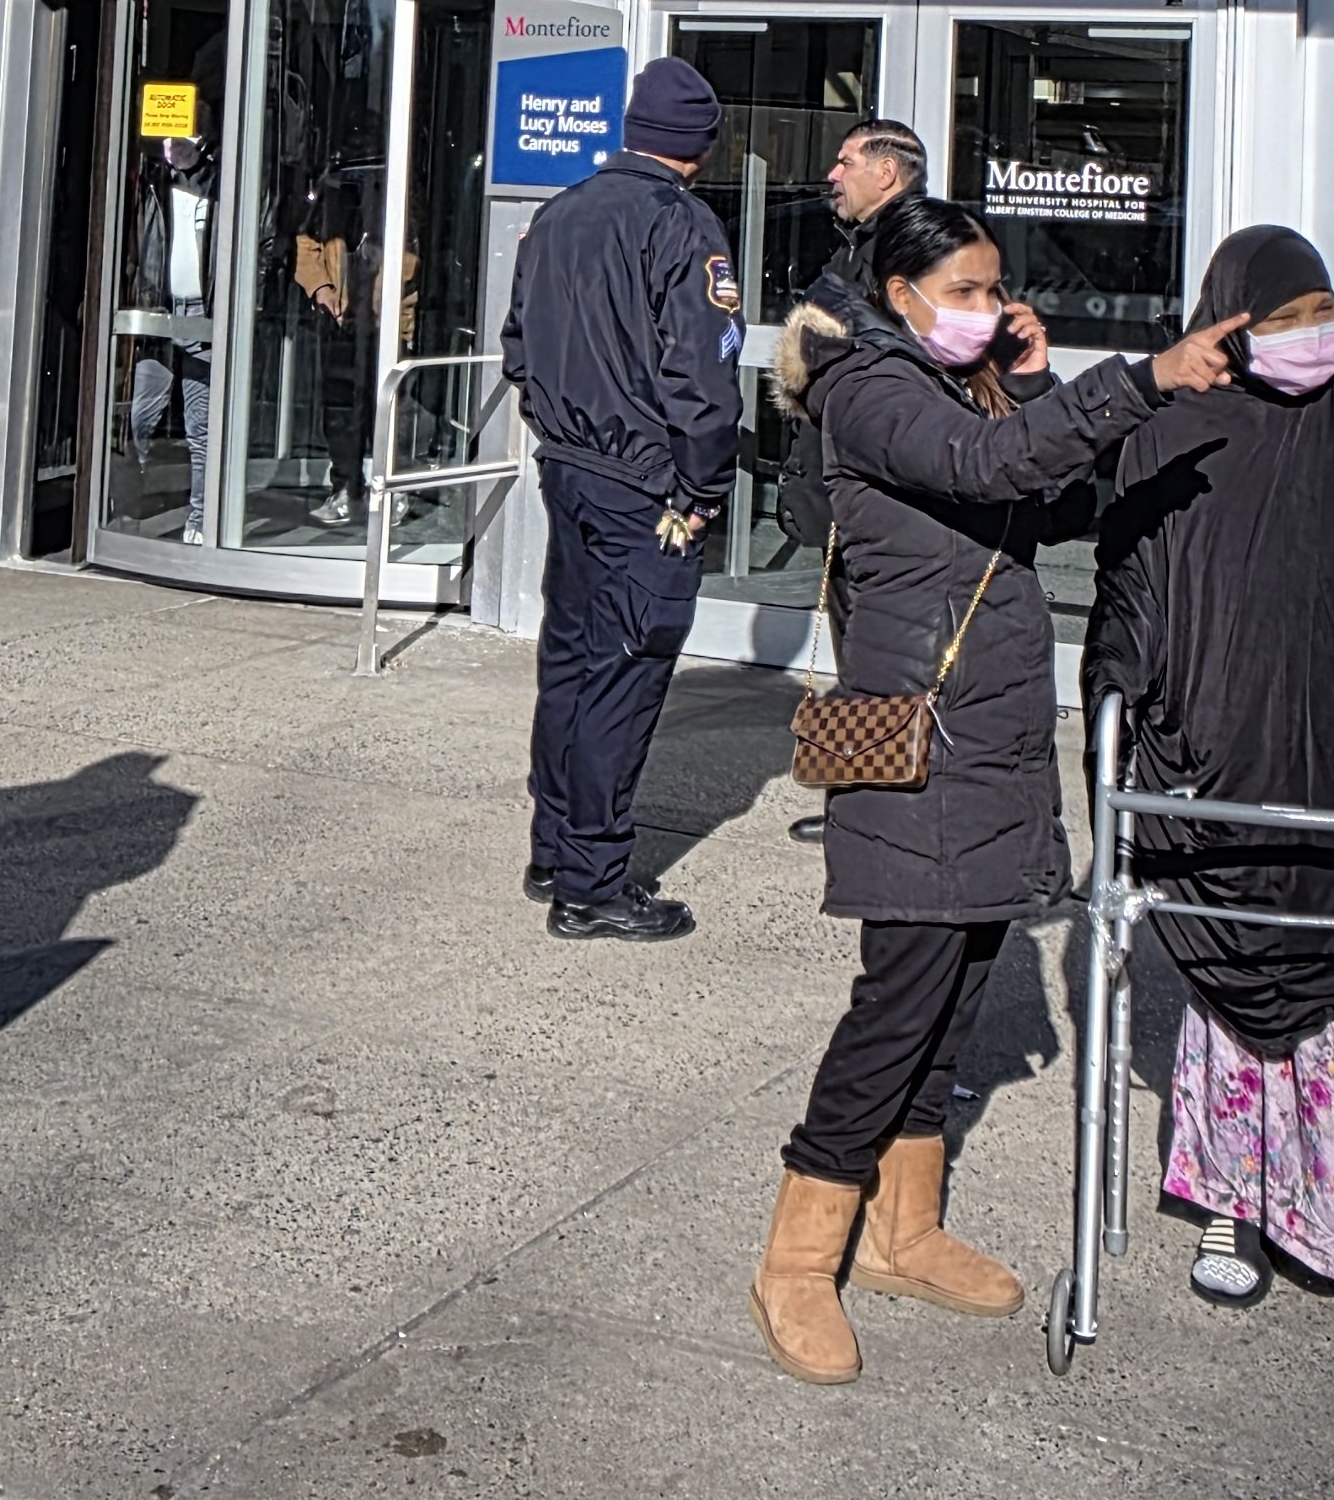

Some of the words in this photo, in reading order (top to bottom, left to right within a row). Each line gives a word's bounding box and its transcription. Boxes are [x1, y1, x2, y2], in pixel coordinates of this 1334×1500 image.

[505, 16, 610, 37] Montefiore
[521, 94, 567, 115] Henry
[570, 96, 600, 113] and
[520, 114, 554, 134] Lucy
[558, 116, 607, 134] Moses
[518, 134, 580, 155] Campus
[986, 160, 1149, 195] Montefiore
[985, 205, 1016, 215] ALBERT
[1017, 207, 1053, 217] EINSTEIN
[1054, 209, 1090, 219] COLLEGE
[1091, 210, 1103, 219] OF
[1104, 211, 1146, 221] MEDICINE
[986, 195, 1005, 203] THE
[1008, 196, 1067, 206] UNIVERSITY
[1071, 199, 1121, 209] HOSPITAL
[1125, 201, 1145, 210] FOR
